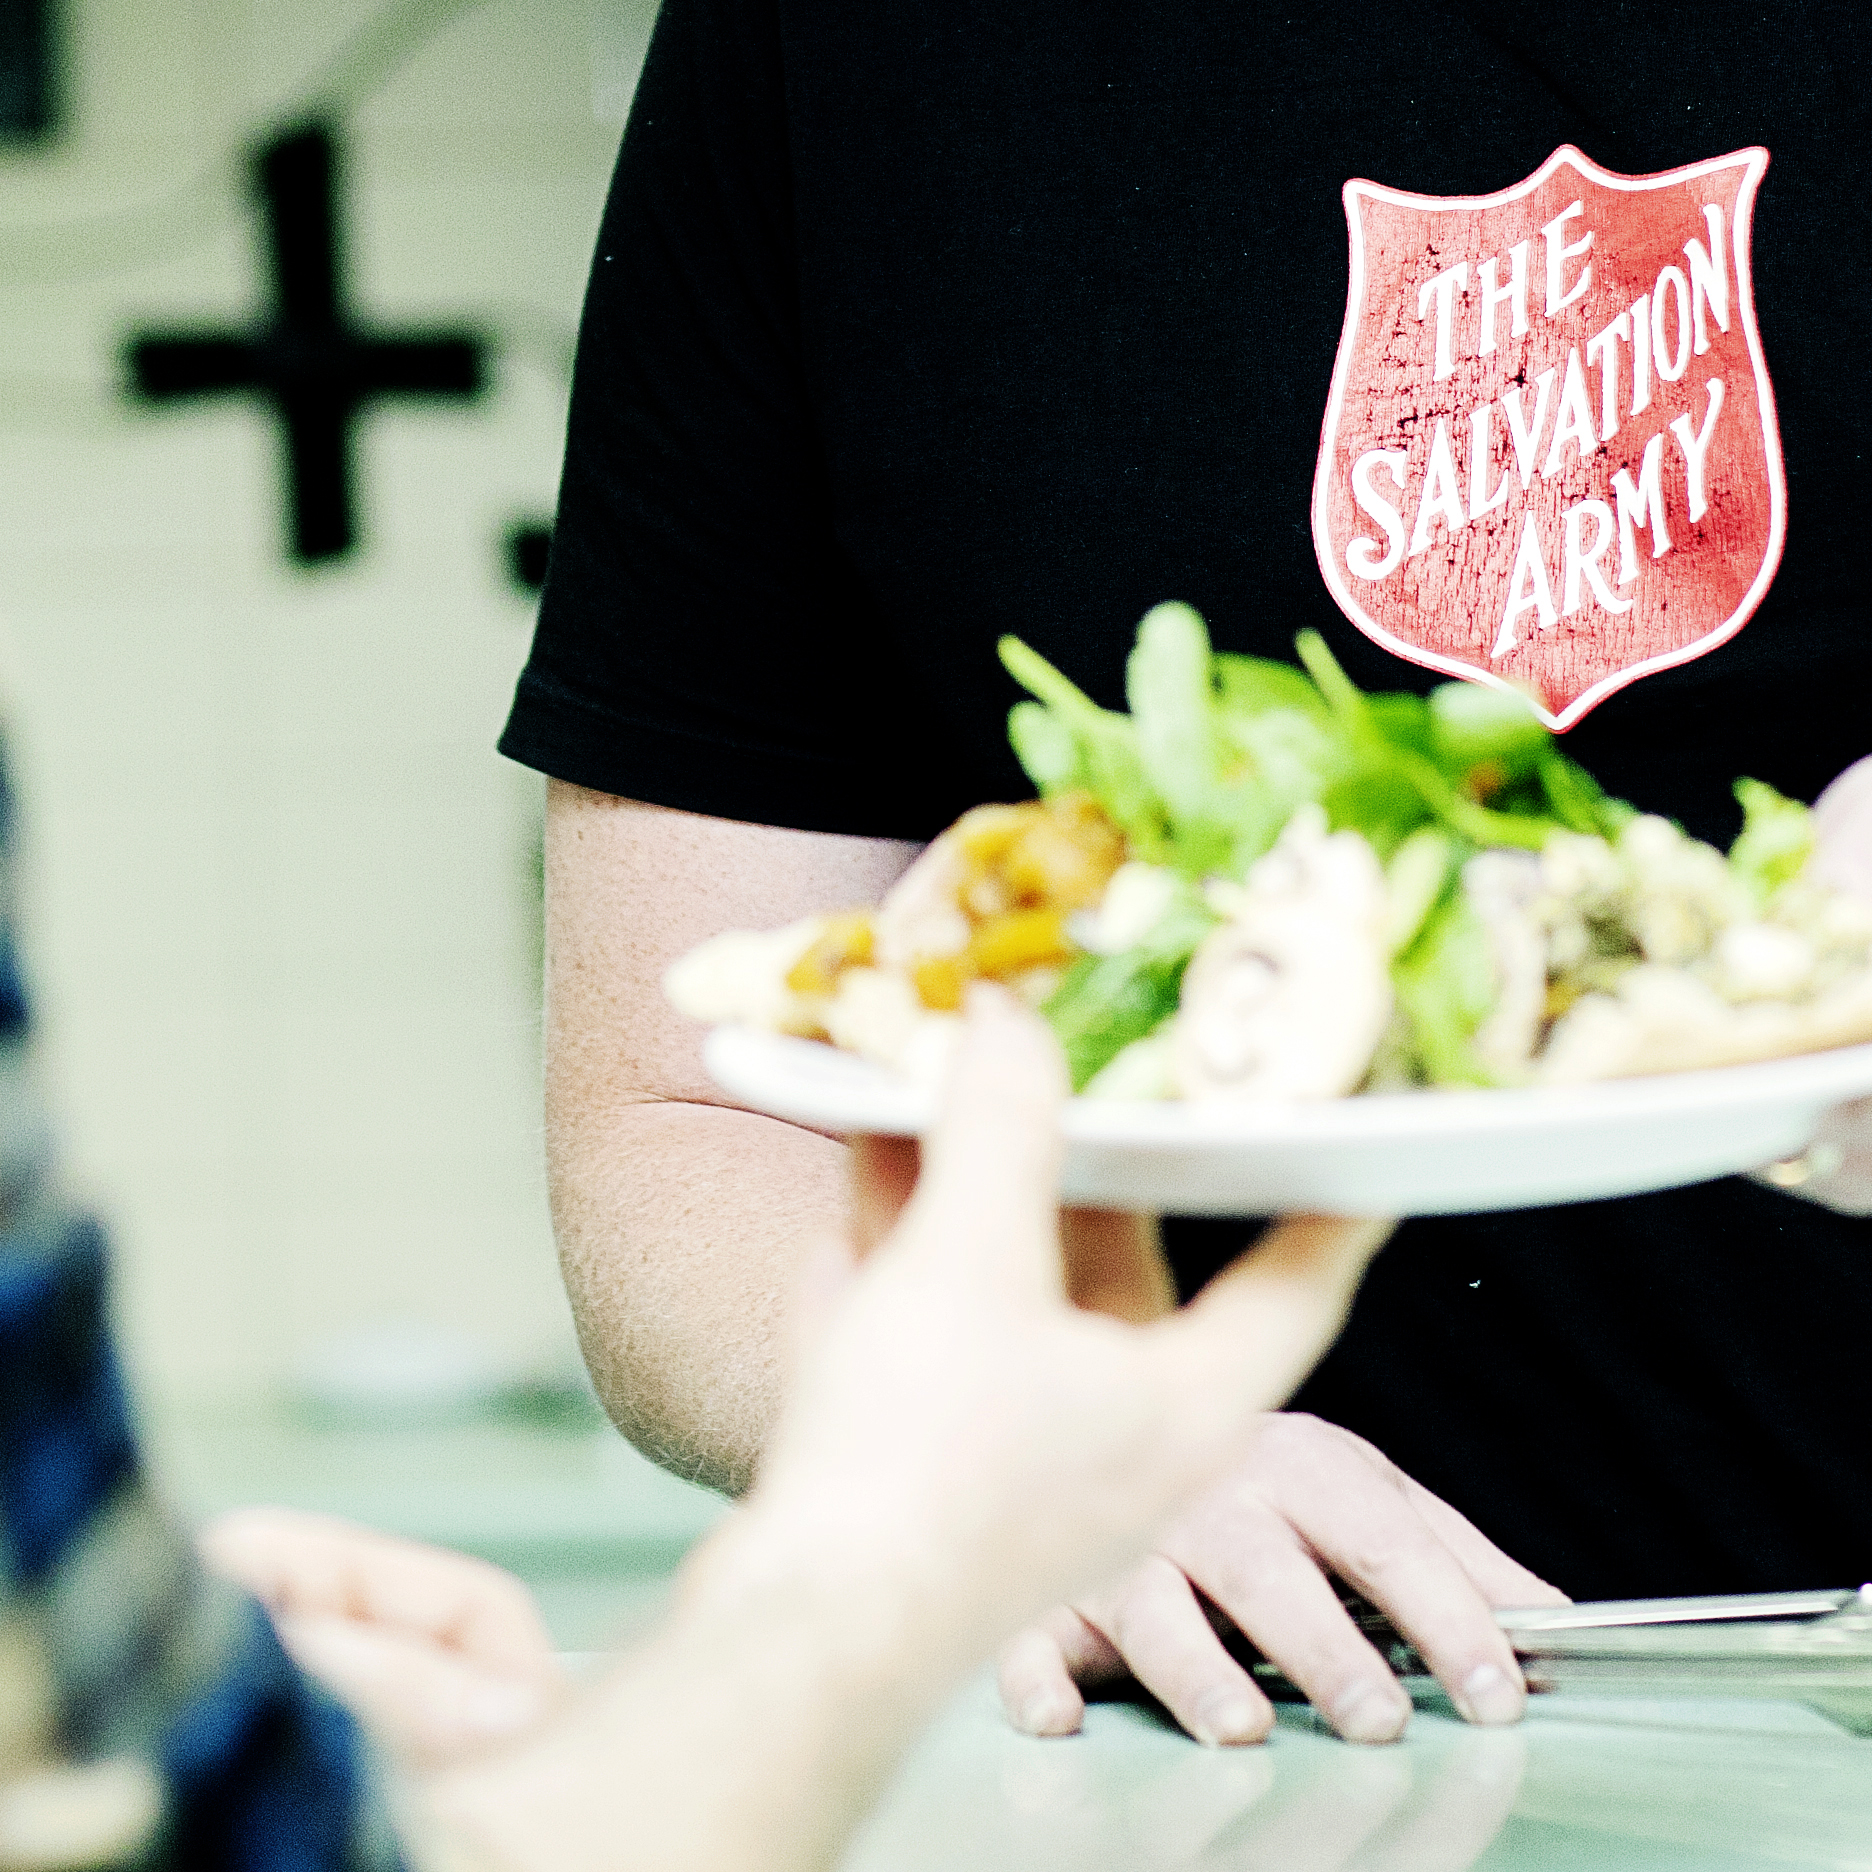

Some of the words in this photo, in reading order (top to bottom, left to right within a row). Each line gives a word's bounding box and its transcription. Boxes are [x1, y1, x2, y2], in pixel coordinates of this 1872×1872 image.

[1346, 203, 1730, 580] SALVATION
[1418, 200, 1594, 382] THE
[1490, 377, 1726, 659] ARMY
